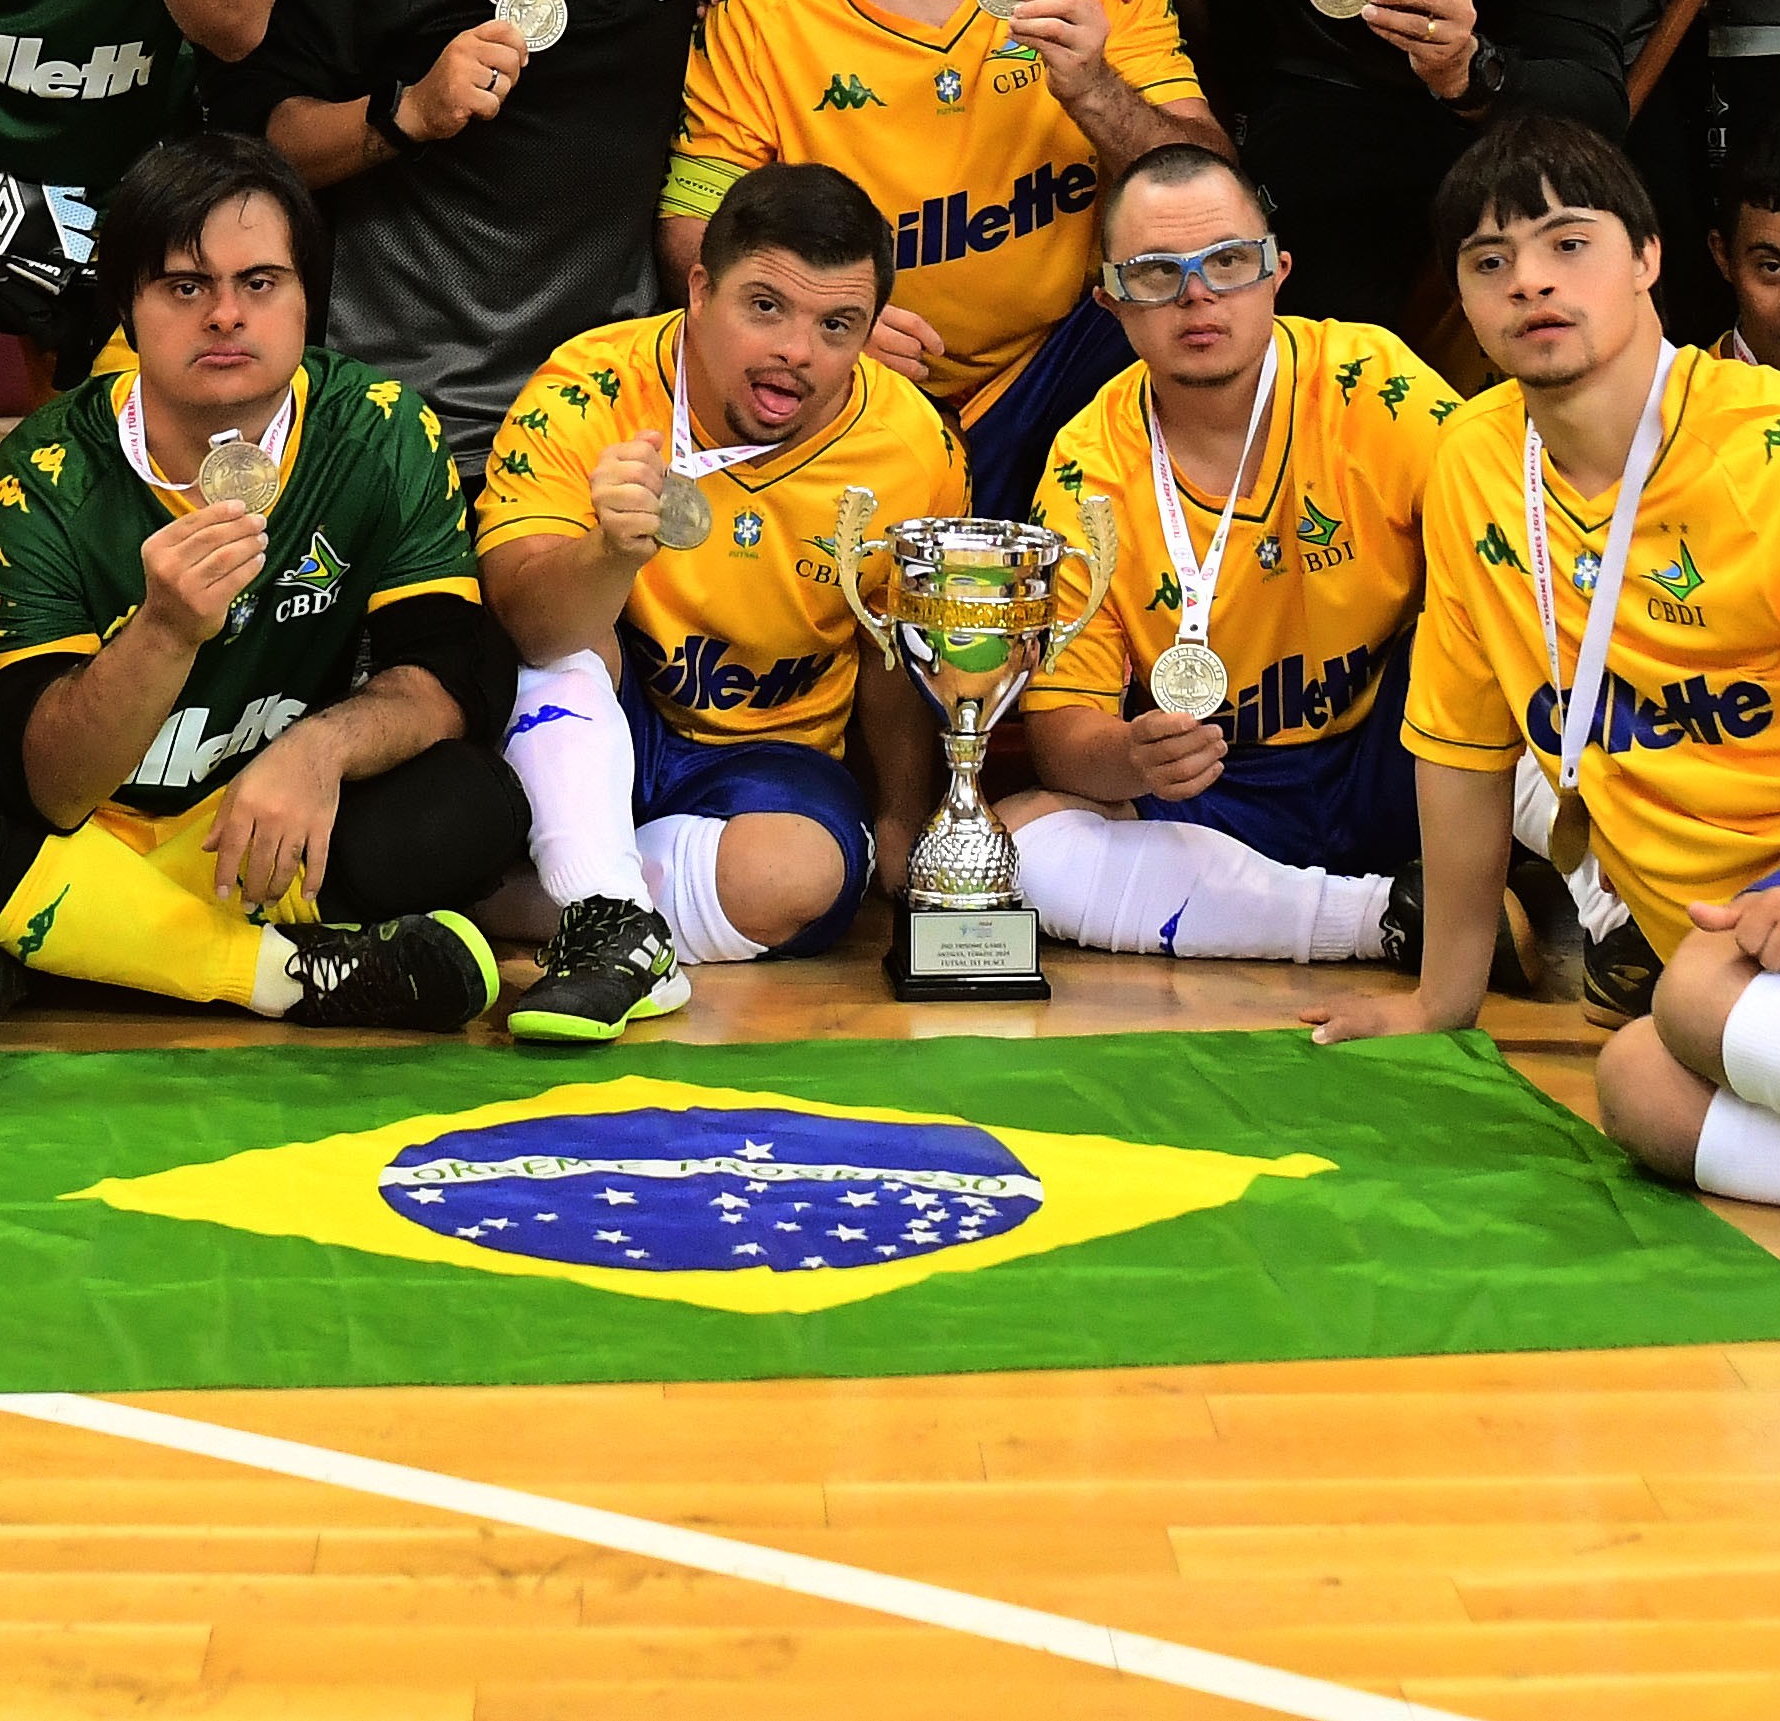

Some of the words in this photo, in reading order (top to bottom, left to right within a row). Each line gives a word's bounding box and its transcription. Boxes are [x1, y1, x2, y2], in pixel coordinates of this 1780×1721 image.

[896, 162, 1097, 270] illette
[1529, 445, 1537, 492] ANTALYA
[1531, 506, 1540, 531] 2024
[1303, 541, 1355, 574] BDI
[1535, 535, 1545, 573] GAMES
[1648, 598, 1707, 627] CBDI
